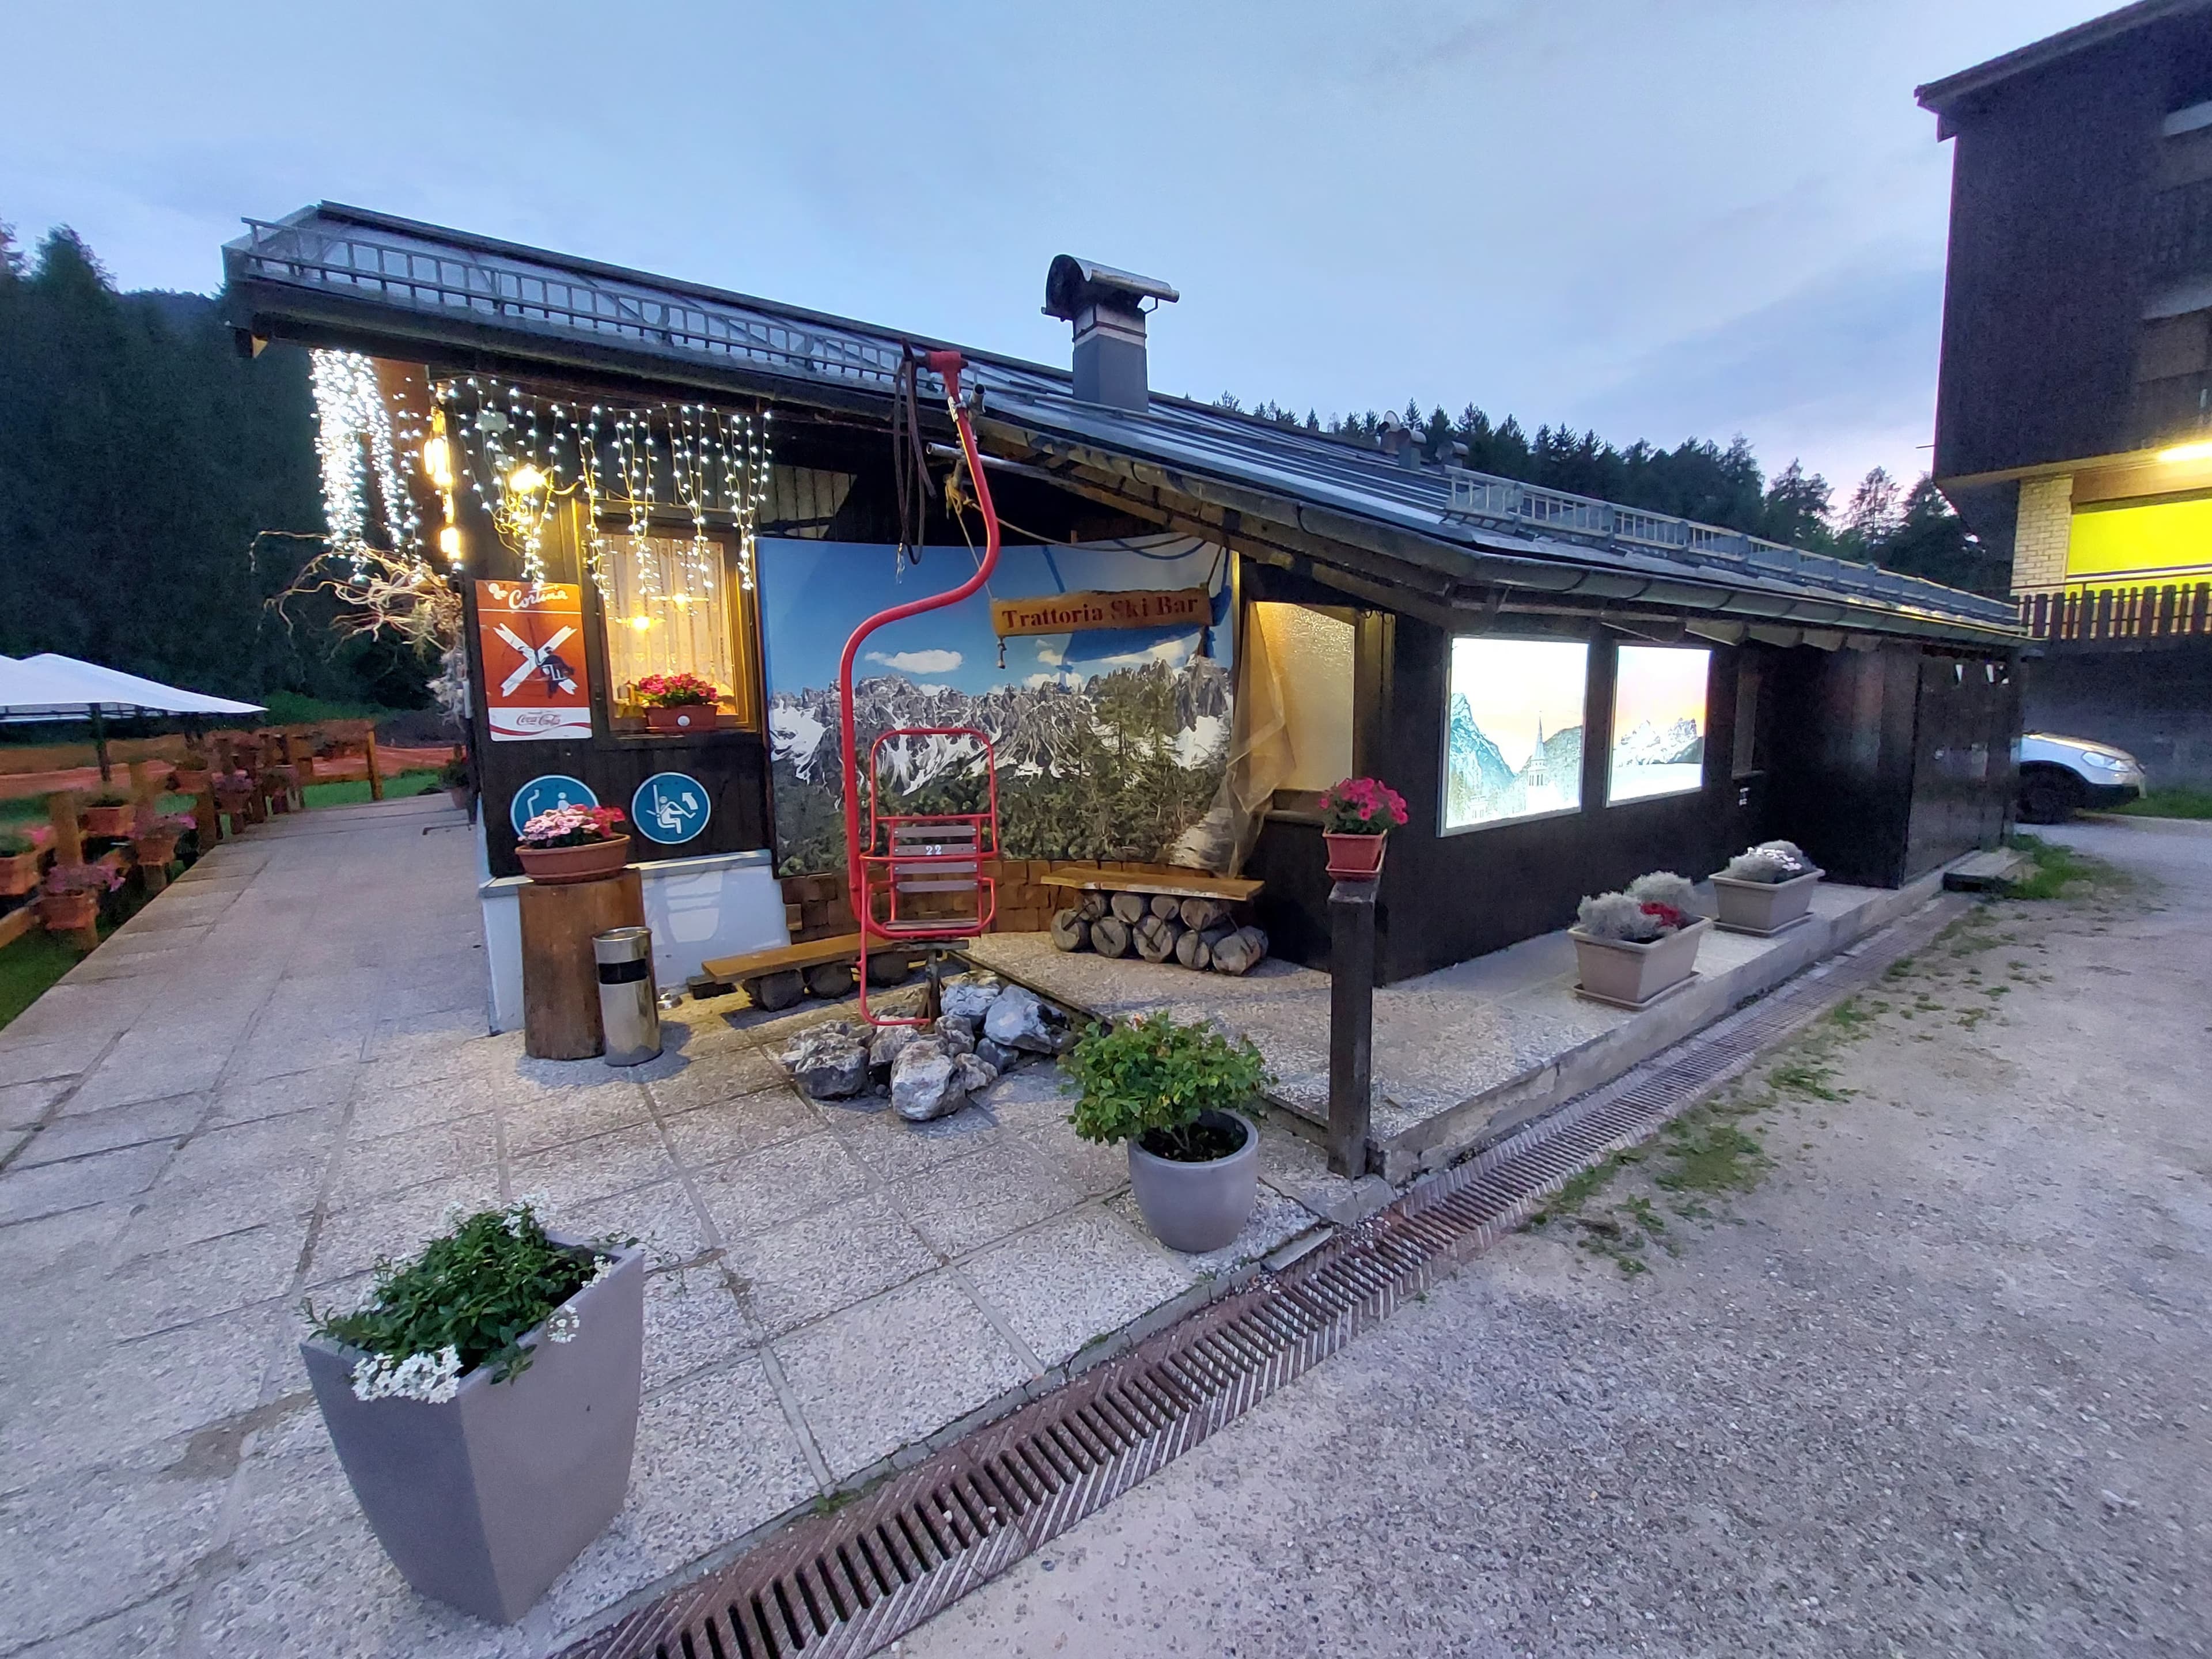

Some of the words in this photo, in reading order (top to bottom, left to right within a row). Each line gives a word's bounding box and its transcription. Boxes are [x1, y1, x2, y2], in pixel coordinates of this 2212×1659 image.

[509, 585, 569, 609] Cortina
[1002, 604, 1103, 628] Trattoria
[1111, 597, 1148, 619] Ski
[1157, 596, 1198, 616] Bar
[925, 844, 942, 855] 22
